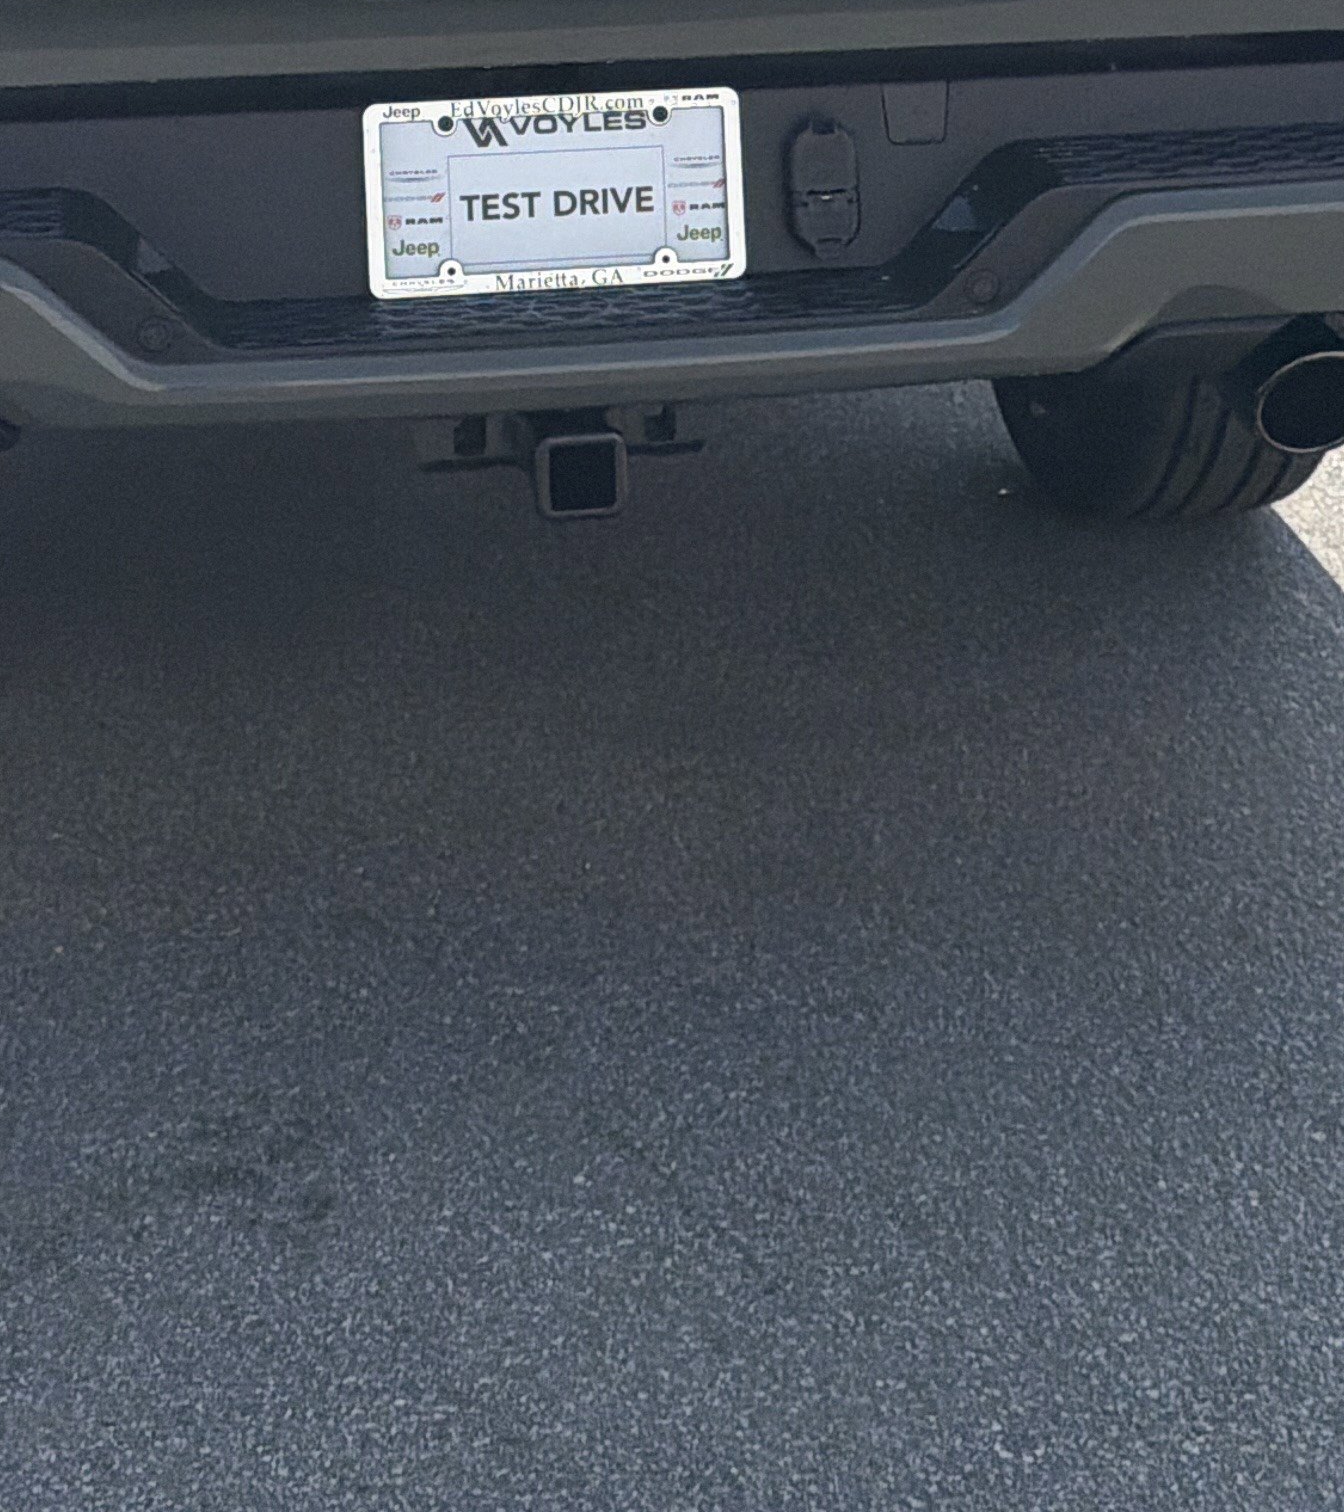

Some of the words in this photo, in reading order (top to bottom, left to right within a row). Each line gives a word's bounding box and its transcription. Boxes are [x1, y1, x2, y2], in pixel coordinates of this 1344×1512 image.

[382, 105, 421, 121] Jeep
[451, 94, 644, 123] EdVoylesCDJR.com
[681, 93, 720, 101] RAM
[509, 110, 647, 136] VOYLES
[459, 191, 542, 222] TEST
[554, 186, 655, 217] DRIVE
[677, 224, 722, 242] Jeep
[392, 239, 440, 258] Jeep
[495, 271, 586, 291] Marietta,
[592, 268, 624, 286] GA
